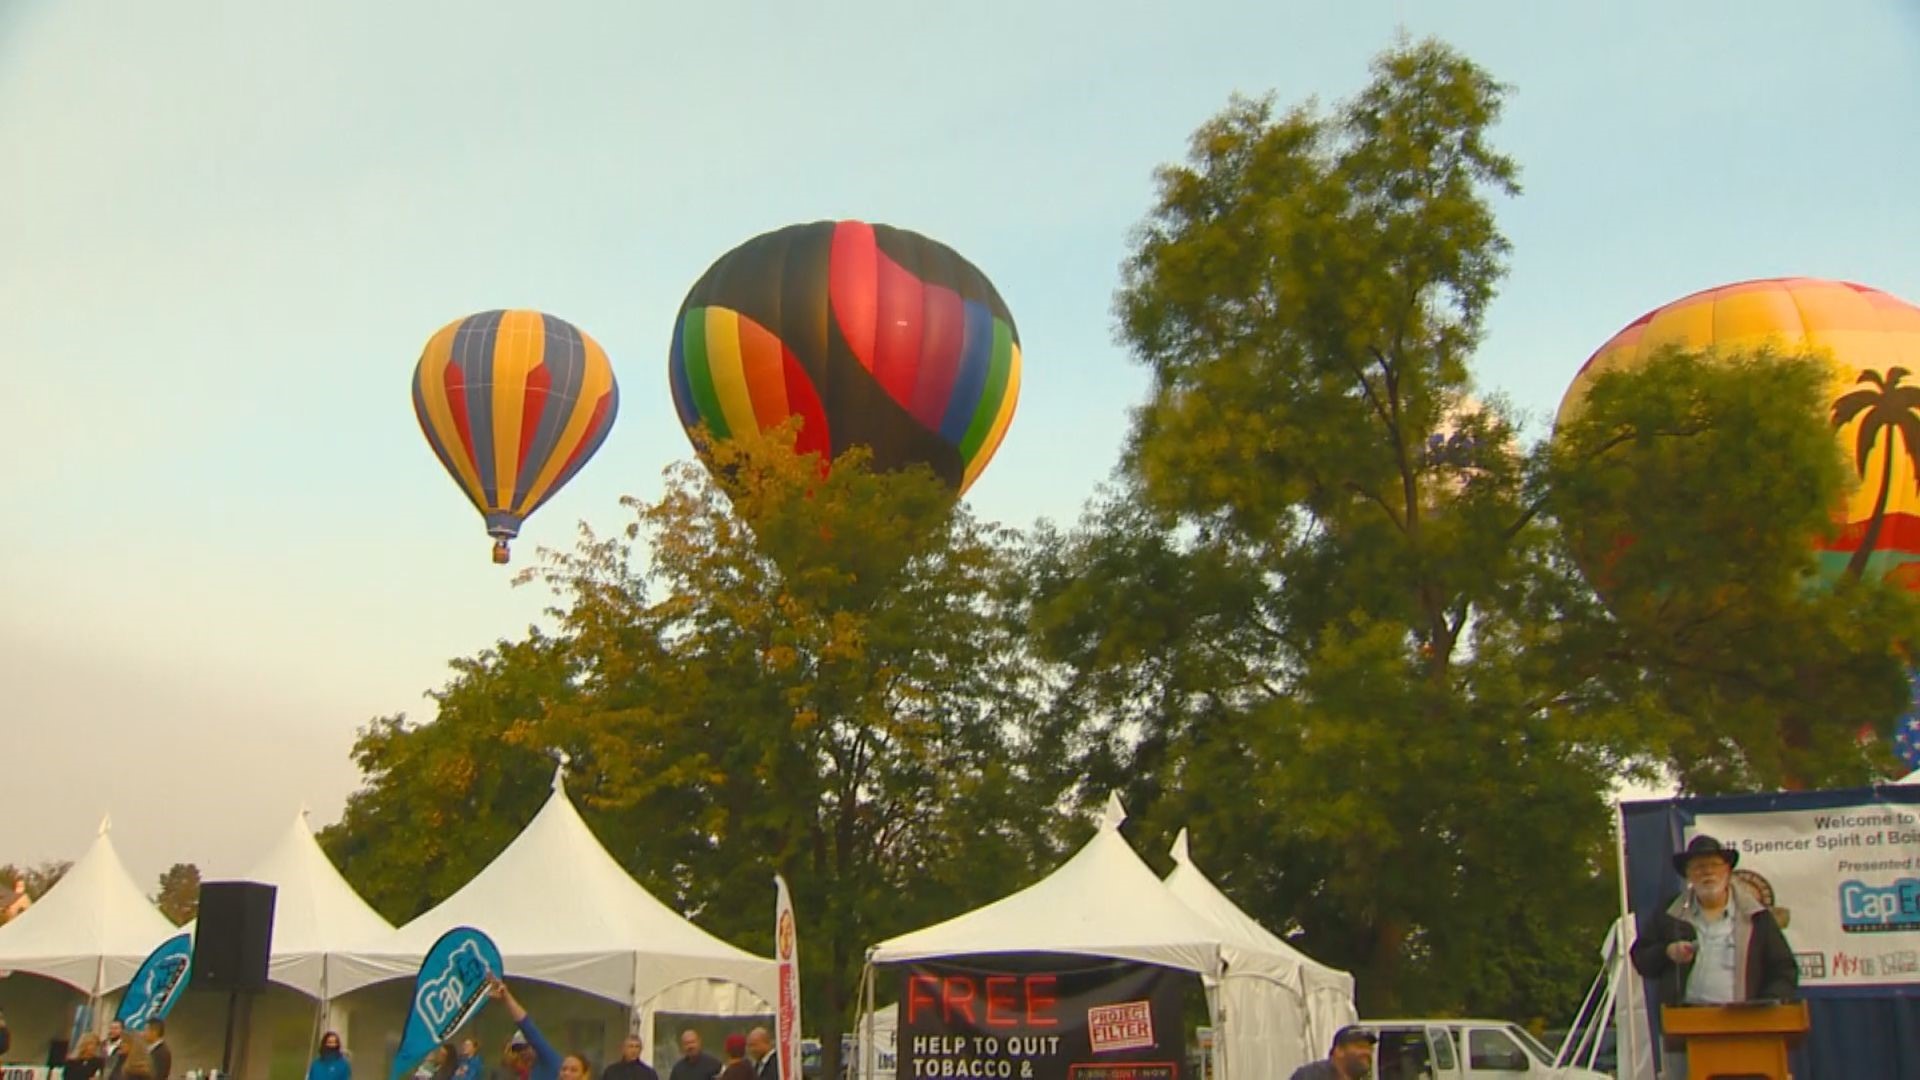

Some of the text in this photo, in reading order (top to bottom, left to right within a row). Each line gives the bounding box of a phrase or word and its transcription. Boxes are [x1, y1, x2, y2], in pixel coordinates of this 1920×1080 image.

[1815, 813, 1914, 829] Welcome to
[1743, 838, 1810, 854] Spencer
[1816, 833, 1861, 850] Spirit
[1866, 831, 1883, 846] of
[1839, 858, 1911, 872] Presented
[908, 975, 1058, 1025] FREE
[1094, 1022, 1149, 1044] FILTER
[913, 1036, 966, 1054] HELP
[973, 1036, 998, 1054] TO
[1007, 1036, 1059, 1055] QUIT
[913, 1058, 1011, 1077] TOBACCO
[1020, 1060, 1033, 1078] &
